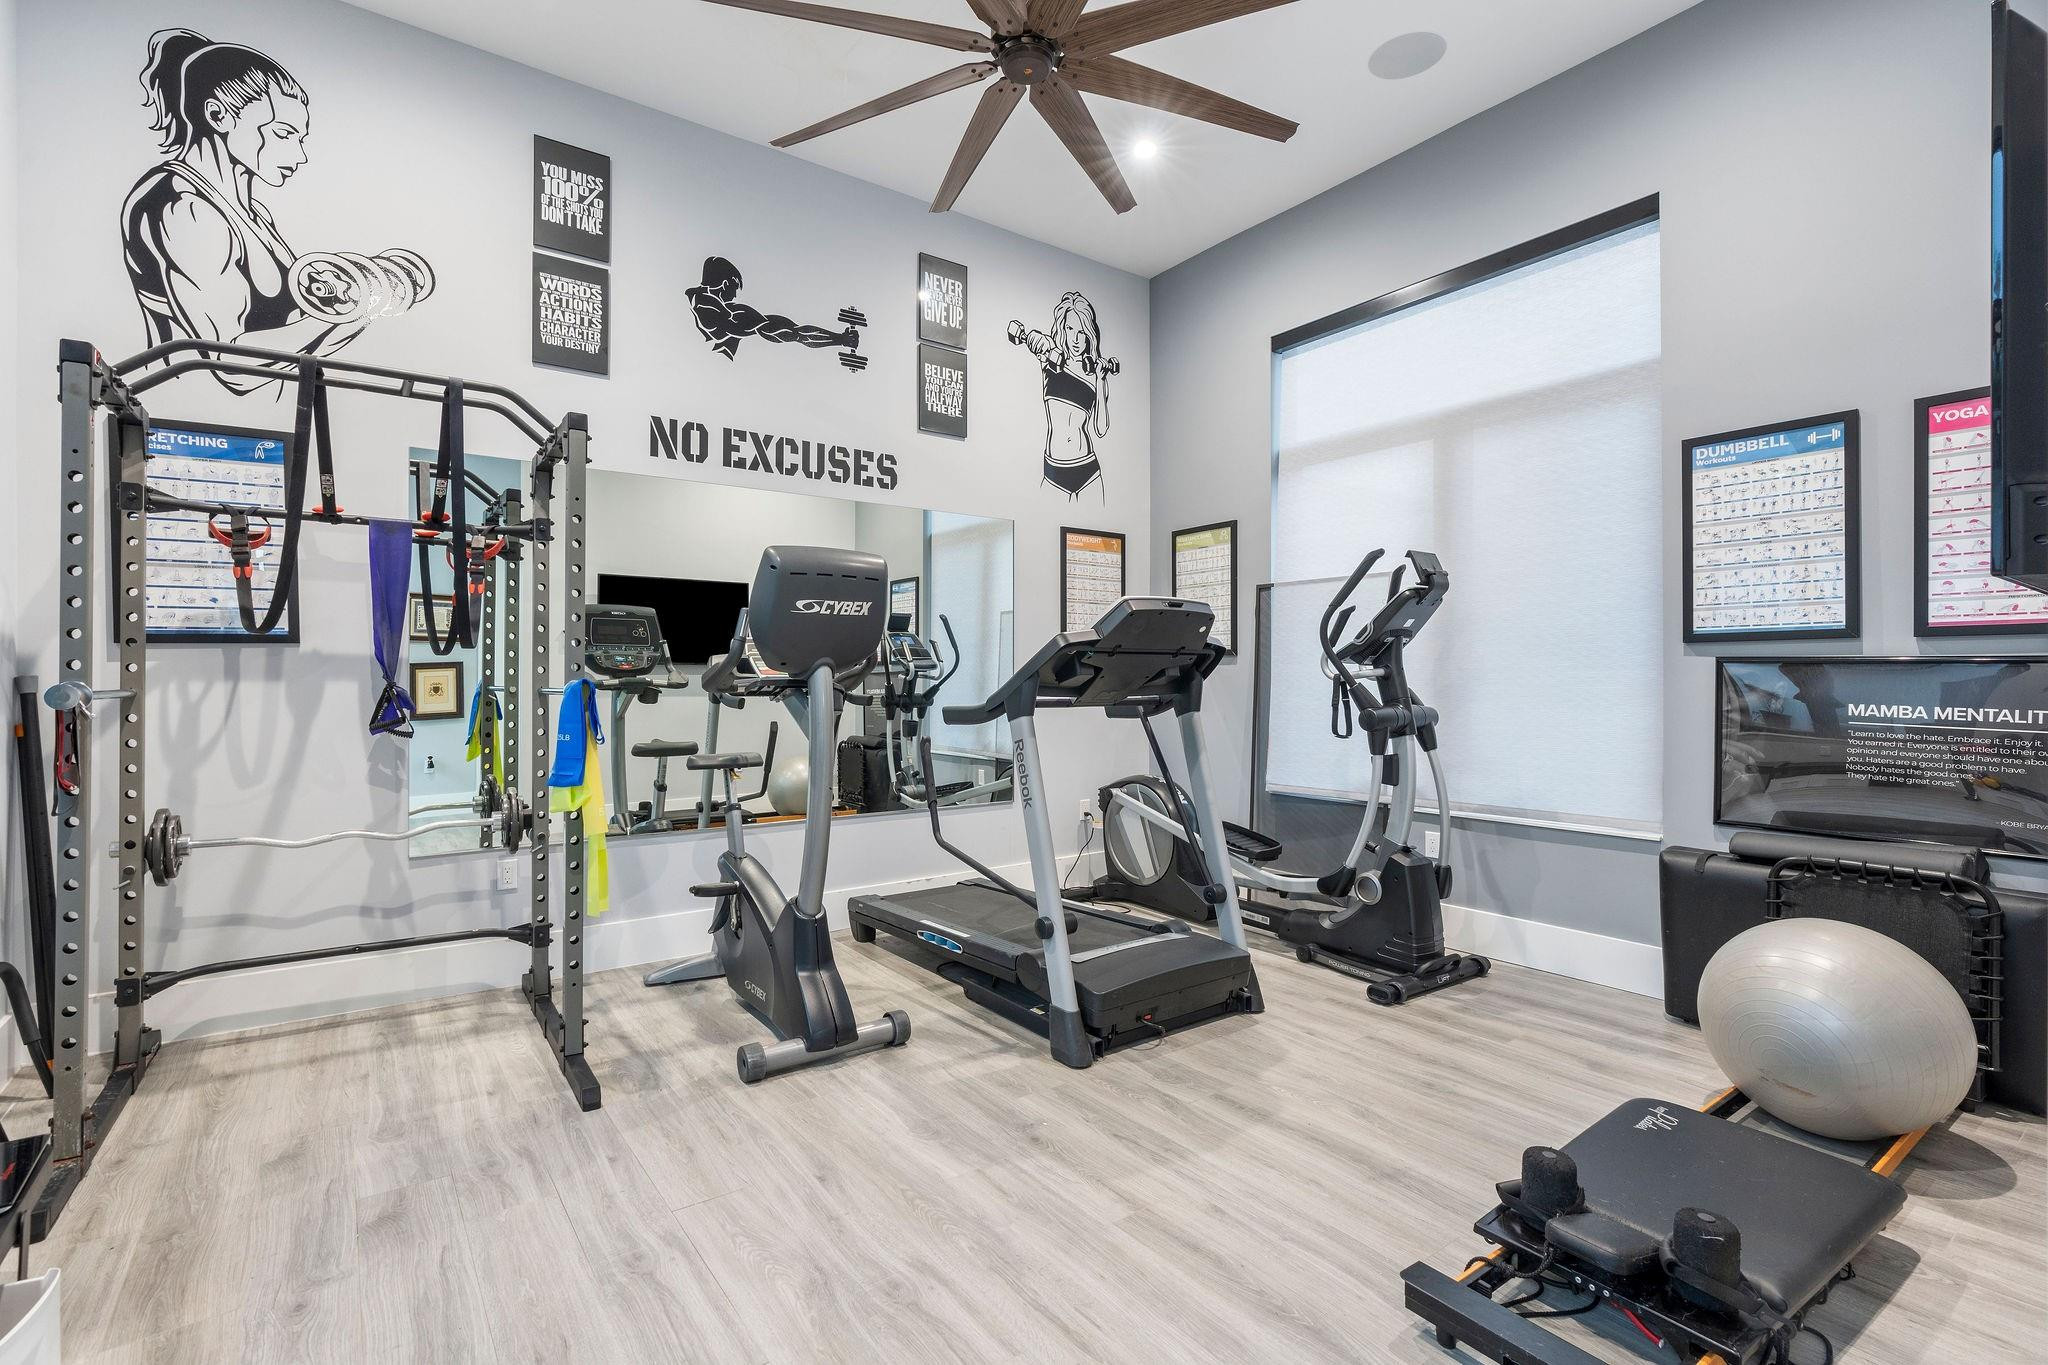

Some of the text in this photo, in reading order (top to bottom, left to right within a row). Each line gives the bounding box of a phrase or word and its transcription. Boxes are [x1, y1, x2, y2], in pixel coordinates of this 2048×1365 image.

[541, 161, 604, 191] YOU MISS
[542, 176, 604, 209] 100%
[541, 193, 603, 220] OF THE SHOTS YOU
[541, 204, 604, 235] DON'T TAKE
[540, 276, 602, 301] WORDS
[924, 271, 963, 298] NEVER
[540, 291, 602, 315] ACTIONS
[925, 288, 963, 307] EVER NEVER
[540, 306, 602, 329] HABITS
[924, 299, 948, 327] GIVE
[540, 321, 601, 343] CHARACTER
[541, 334, 563, 347] YOUR
[565, 339, 600, 354] DESTINY
[924, 362, 964, 384] BELIEVE
[925, 375, 964, 391] YOU CAN
[925, 383, 940, 392] AND
[925, 390, 963, 410] HALFWAY
[927, 402, 963, 418] THERE
[1933, 404, 1989, 423] YOGA
[649, 415, 898, 491] NO EXCUSES
[1696, 434, 1789, 460] DUMBBELL
[1695, 455, 1736, 466] Workouts
[819, 600, 873, 616] CYBEX
[1848, 703, 2048, 724] MAMBA MENTALIT
[1907, 742, 1949, 751] Everyone
[1959, 745, 1998, 753] entitled
[2012, 747, 2036, 756] their
[1923, 734, 1946, 742] hate.
[1947, 736, 1991, 744] Embrace
[2004, 738, 2033, 747] Enjoy
[1846, 747, 1879, 755] opinion
[1899, 751, 1941, 759] everyone
[1942, 753, 1975, 762] should
[1977, 755, 2001, 763] have
[1014, 738, 1032, 810] Reebok
[1846, 763, 1880, 773] Nobody
[1881, 765, 1905, 774] hates
[1923, 770, 1949, 778] good
[1866, 756, 1895, 764] Haters
[1918, 761, 1944, 769] good
[1945, 763, 1987, 771] problem
[2001, 766, 2028, 775] have.
[1846, 771, 1867, 780] They
[1868, 773, 1888, 781] hate
[1889, 775, 1905, 783] the
[1905, 777, 1930, 785] great
[2000, 820, 2025, 828] KOBE
[1328, 959, 1349, 971] POWER
[750, 983, 767, 1002] CYBEX
